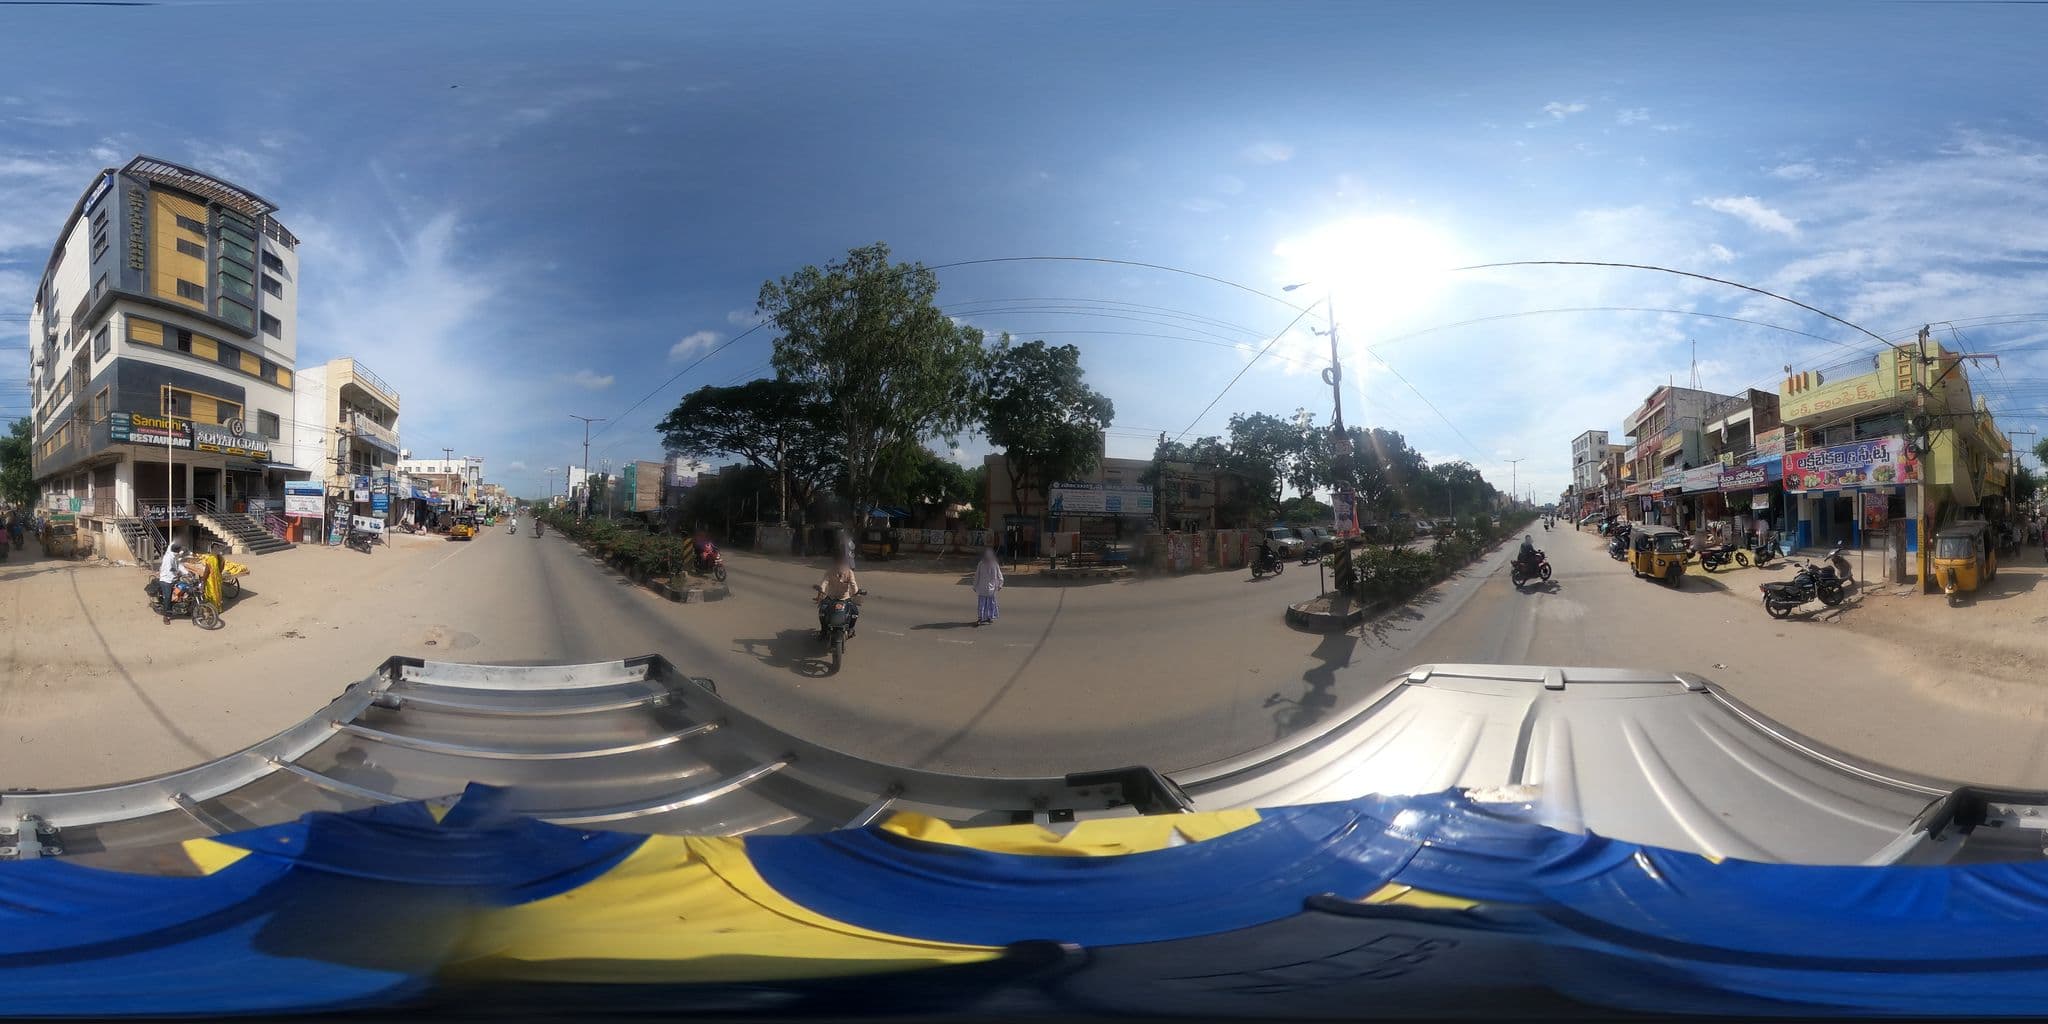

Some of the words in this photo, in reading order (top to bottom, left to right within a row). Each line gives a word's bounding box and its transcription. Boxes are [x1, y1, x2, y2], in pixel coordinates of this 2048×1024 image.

[132, 414, 181, 430] Sannidhi
[129, 433, 191, 447] RESTAURANT
[237, 438, 268, 452] GRAND
